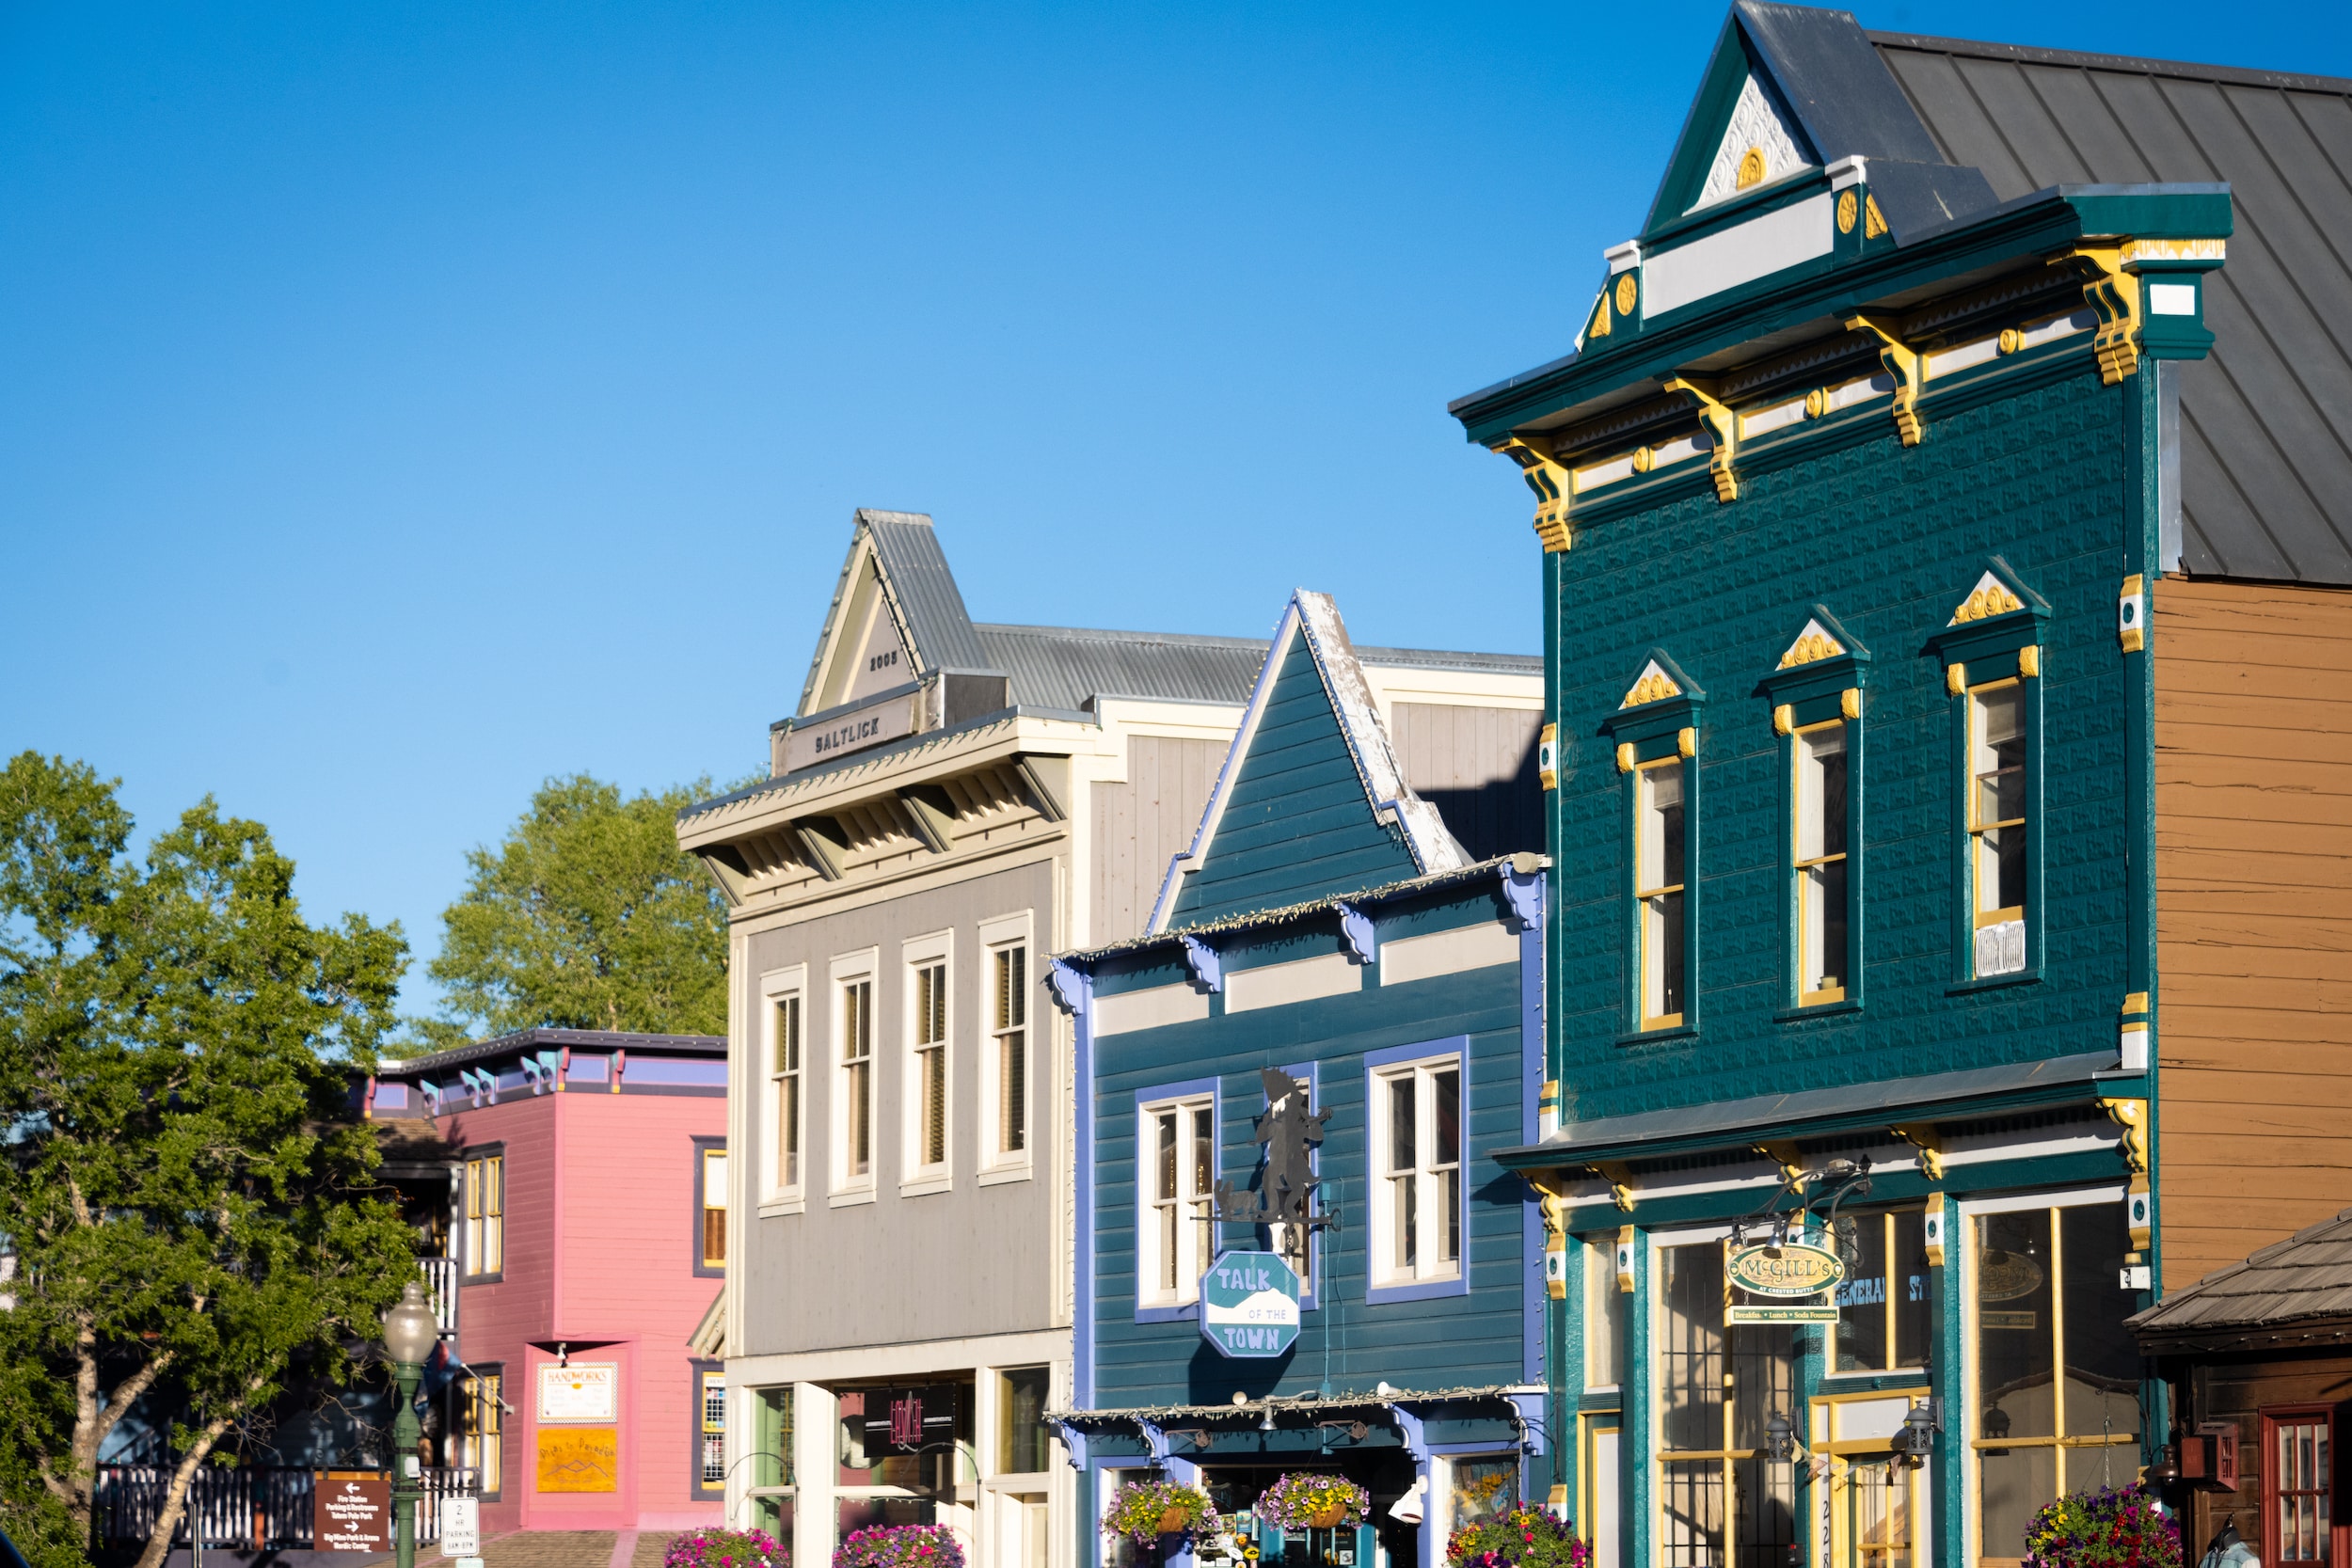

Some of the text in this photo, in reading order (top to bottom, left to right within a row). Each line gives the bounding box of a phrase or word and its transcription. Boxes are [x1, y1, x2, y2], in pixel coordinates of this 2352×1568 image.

[816, 717, 879, 753] SALTLICK
[1216, 1268, 1271, 1291] TALK
[1248, 1309, 1286, 1320] OF THE
[1224, 1328, 1279, 1351] TOWN
[548, 1370, 607, 1383] HANDWORKS
[337, 1495, 368, 1503] Fire Station
[325, 1503, 347, 1513] Parking
[351, 1503, 379, 1512] Restrooms
[456, 1504, 462, 1515] 2
[347, 1512, 359, 1520] Pole
[359, 1512, 373, 1520] Park
[323, 1533, 333, 1543] Big
[333, 1533, 346, 1542] Mine
[346, 1533, 359, 1542] Park
[352, 1542, 370, 1550] Center
